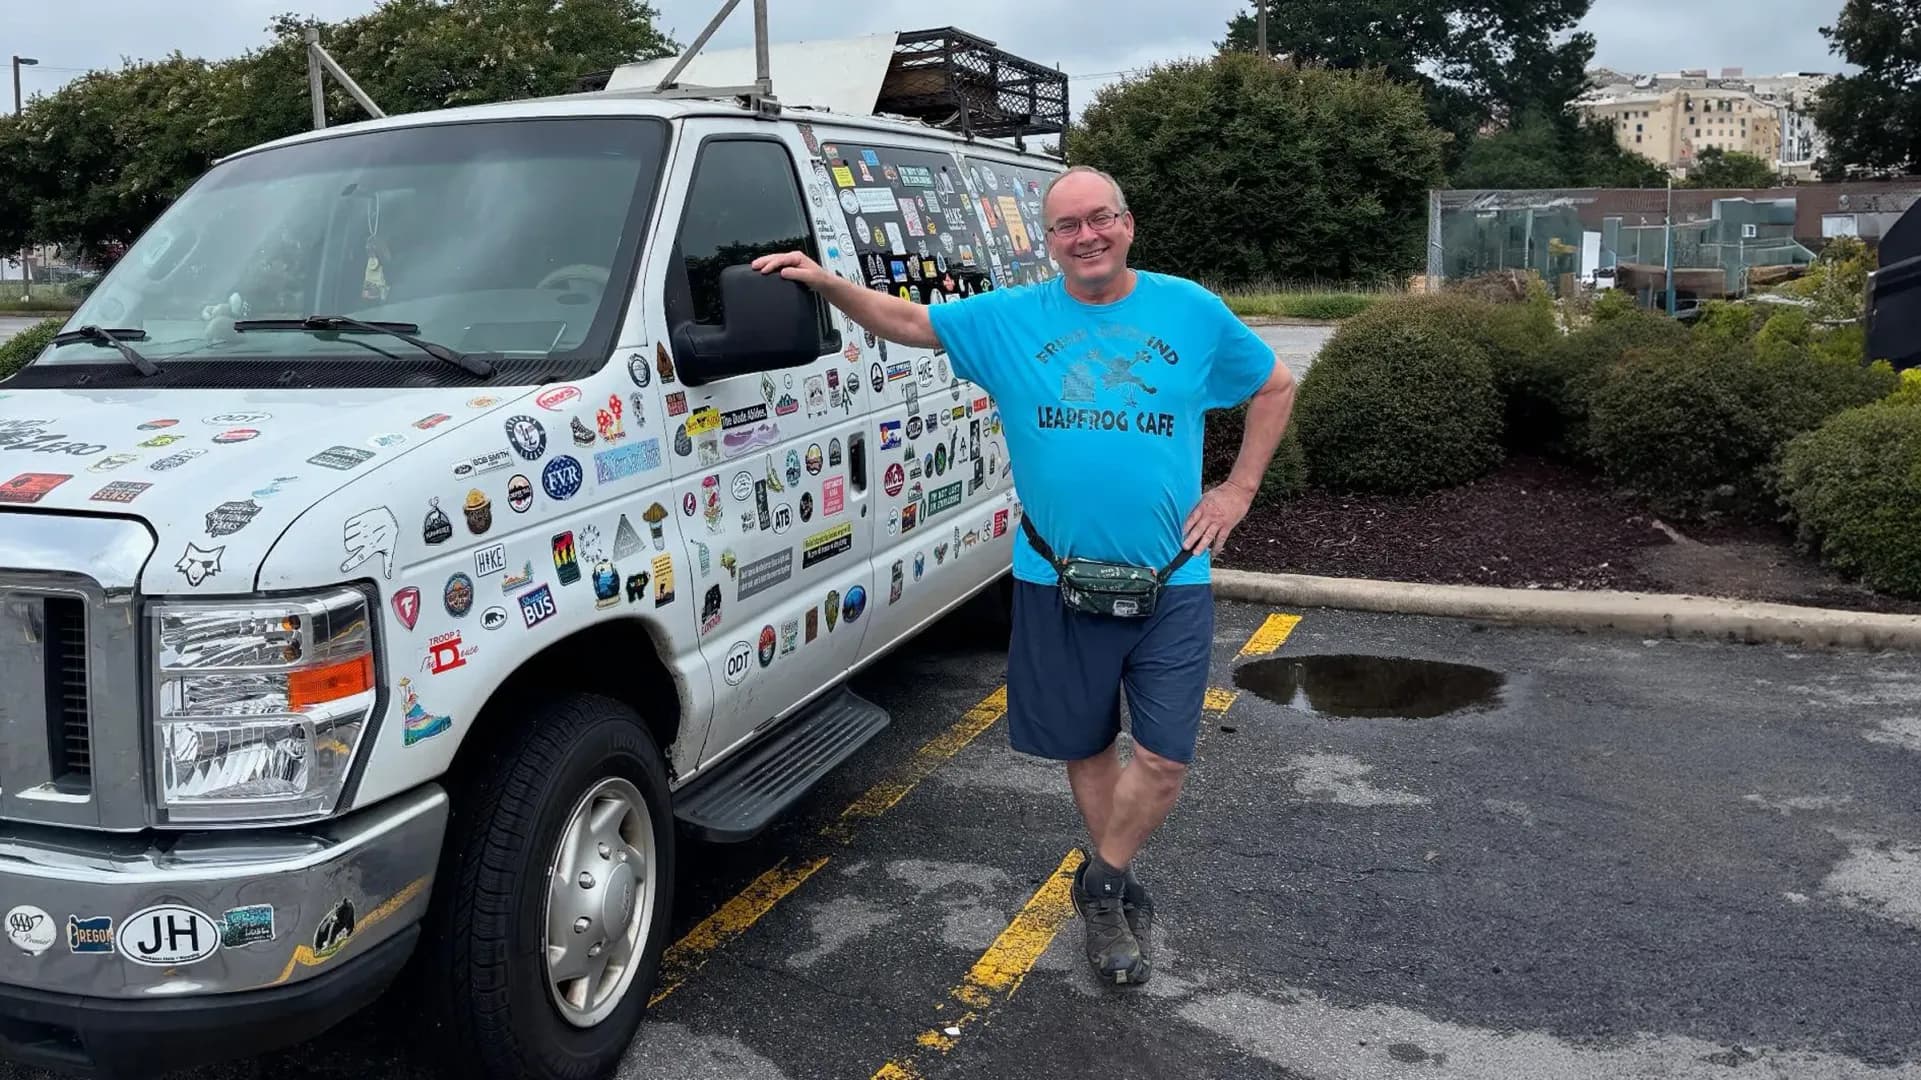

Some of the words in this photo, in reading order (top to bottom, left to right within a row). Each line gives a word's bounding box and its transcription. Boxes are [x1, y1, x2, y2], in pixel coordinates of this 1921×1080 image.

[1038, 405, 1129, 431] LEAPFROG
[1136, 412, 1175, 437] CAFE
[775, 508, 790, 530] ATB
[524, 596, 554, 625] BUS
[429, 631, 455, 645] TROOP
[727, 651, 750, 677] ODT
[137, 915, 199, 954] JH
